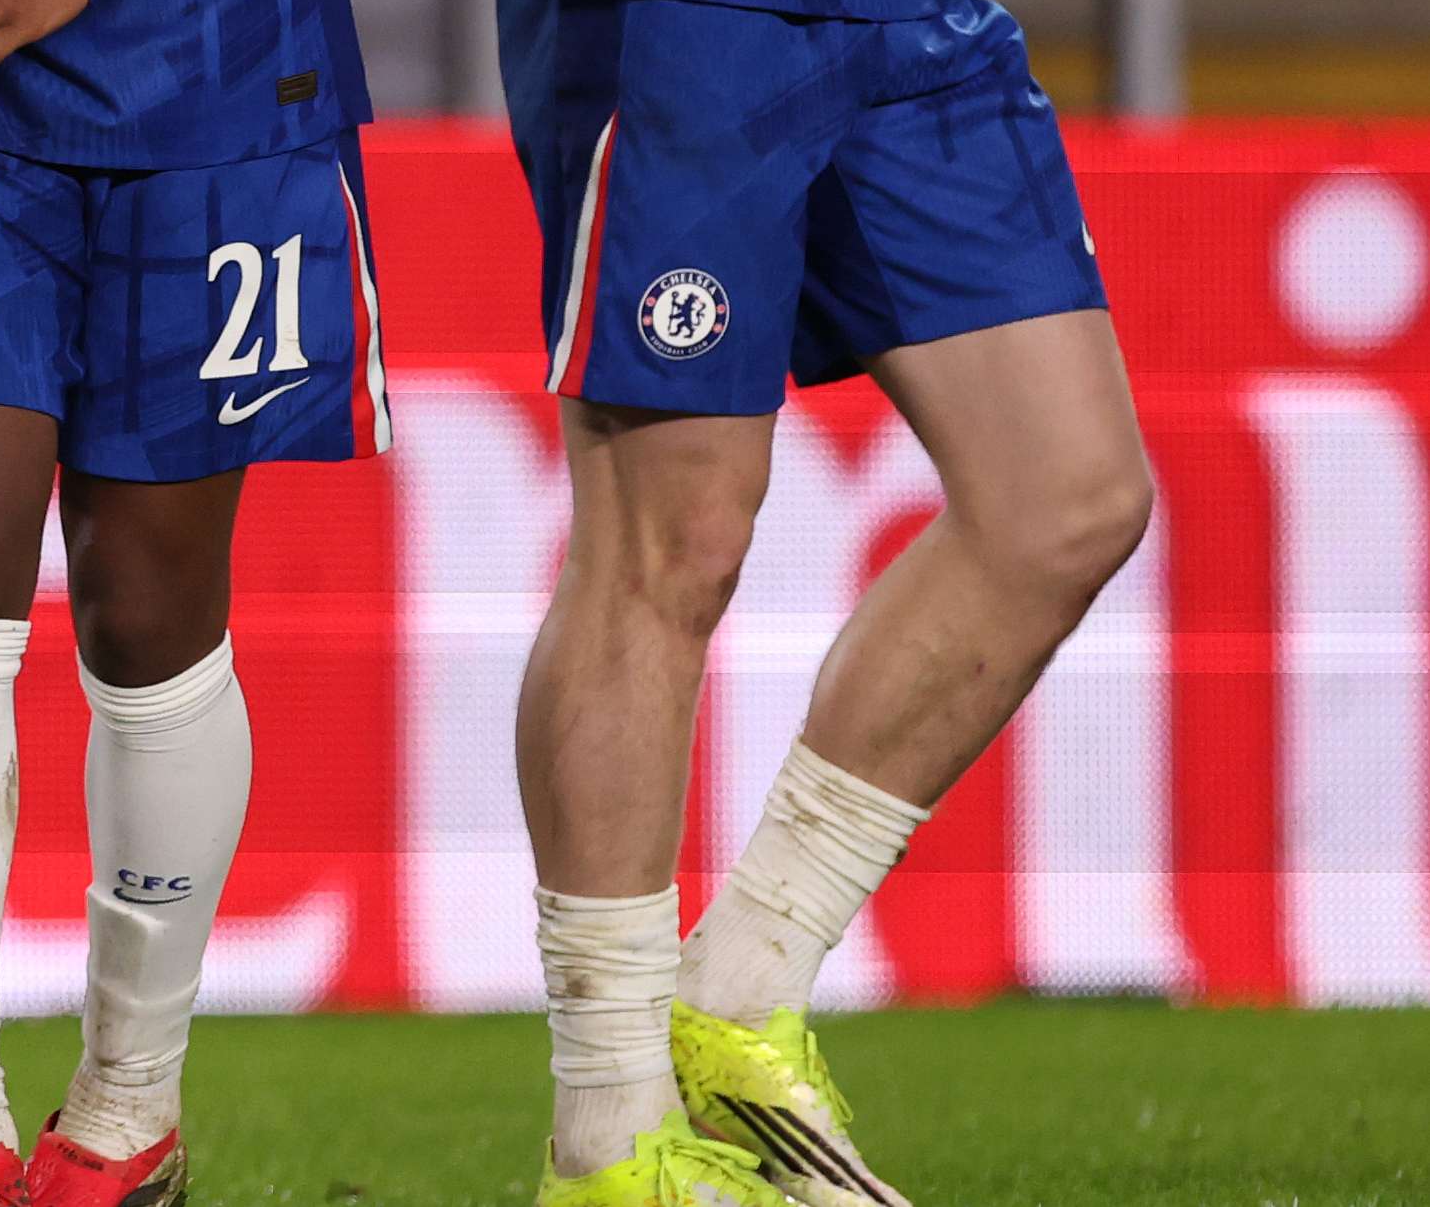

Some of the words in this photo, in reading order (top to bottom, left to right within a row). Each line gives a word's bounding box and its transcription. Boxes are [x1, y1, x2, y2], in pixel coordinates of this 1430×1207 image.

[660, 273, 717, 295] CHELSEA
[199, 234, 309, 379] 21
[117, 868, 192, 891] CFC
